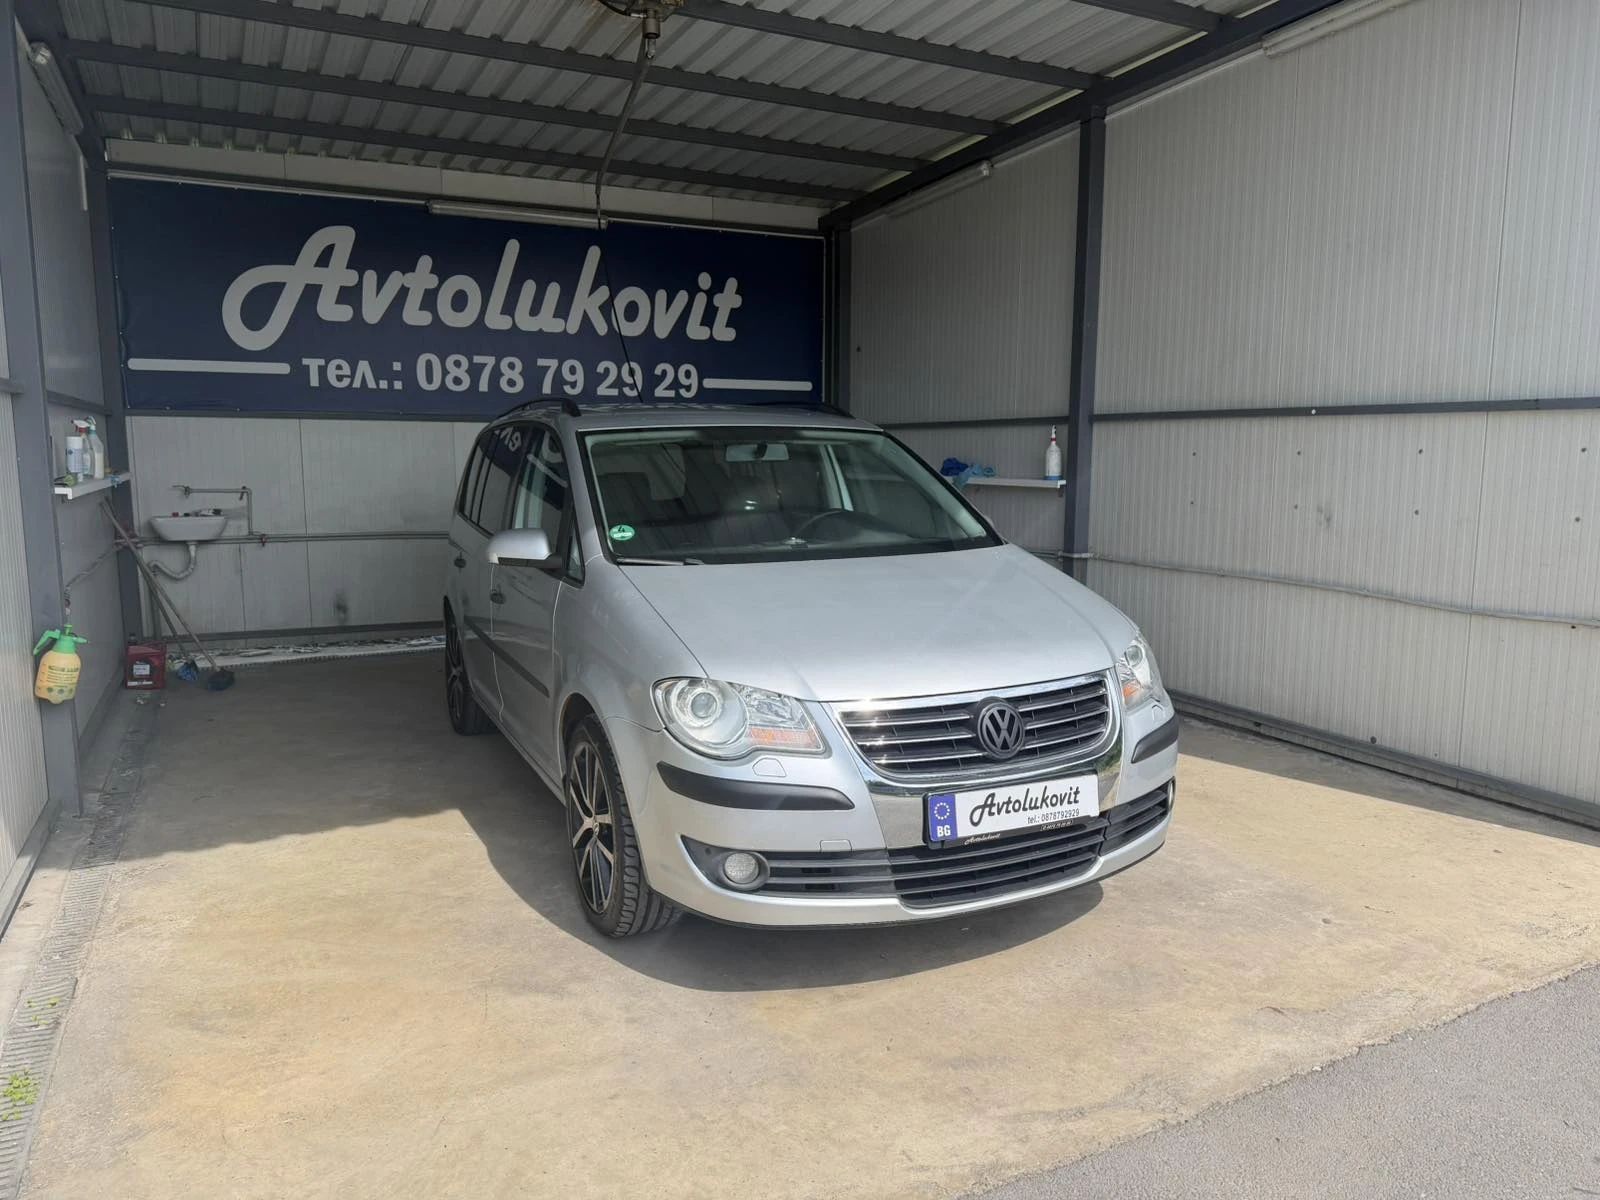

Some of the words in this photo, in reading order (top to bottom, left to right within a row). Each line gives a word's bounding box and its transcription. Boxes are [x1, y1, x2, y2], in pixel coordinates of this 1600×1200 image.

[222, 225, 742, 351] Avtolukovit
[416, 353, 525, 394] 0878
[537, 358, 585, 396] 79
[596, 360, 643, 397] 29
[654, 363, 699, 398] 29
[969, 786, 1080, 827] Avtolukovit
[1041, 809, 1080, 822] 0878792929
[937, 825, 951, 837] BG
